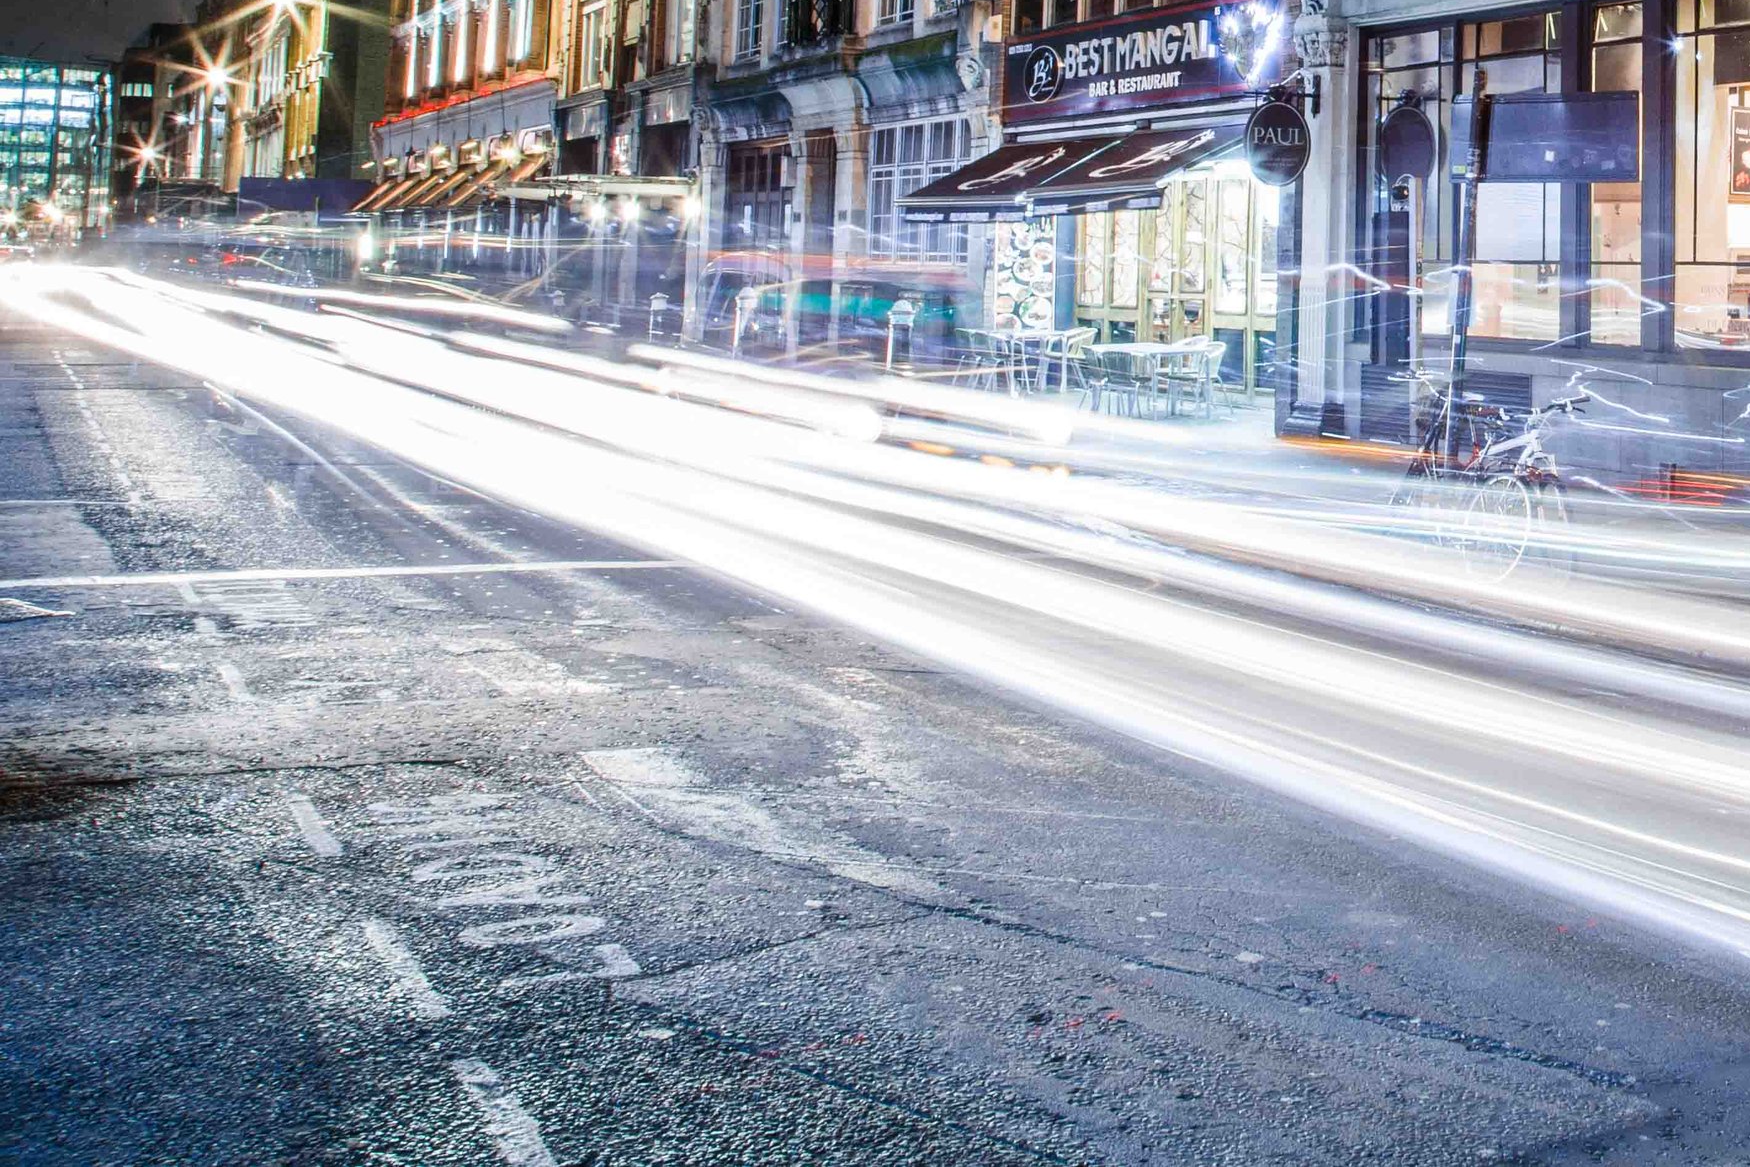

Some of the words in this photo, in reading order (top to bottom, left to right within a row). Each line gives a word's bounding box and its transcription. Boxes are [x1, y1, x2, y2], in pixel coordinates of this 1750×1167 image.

[1064, 38, 1116, 80] BEST
[1115, 19, 1217, 72] MANGAL
[1088, 78, 1109, 98] BAR
[1109, 80, 1116, 95] &
[1117, 71, 1182, 95] RESTAURANT
[1253, 127, 1306, 146] PAUL
